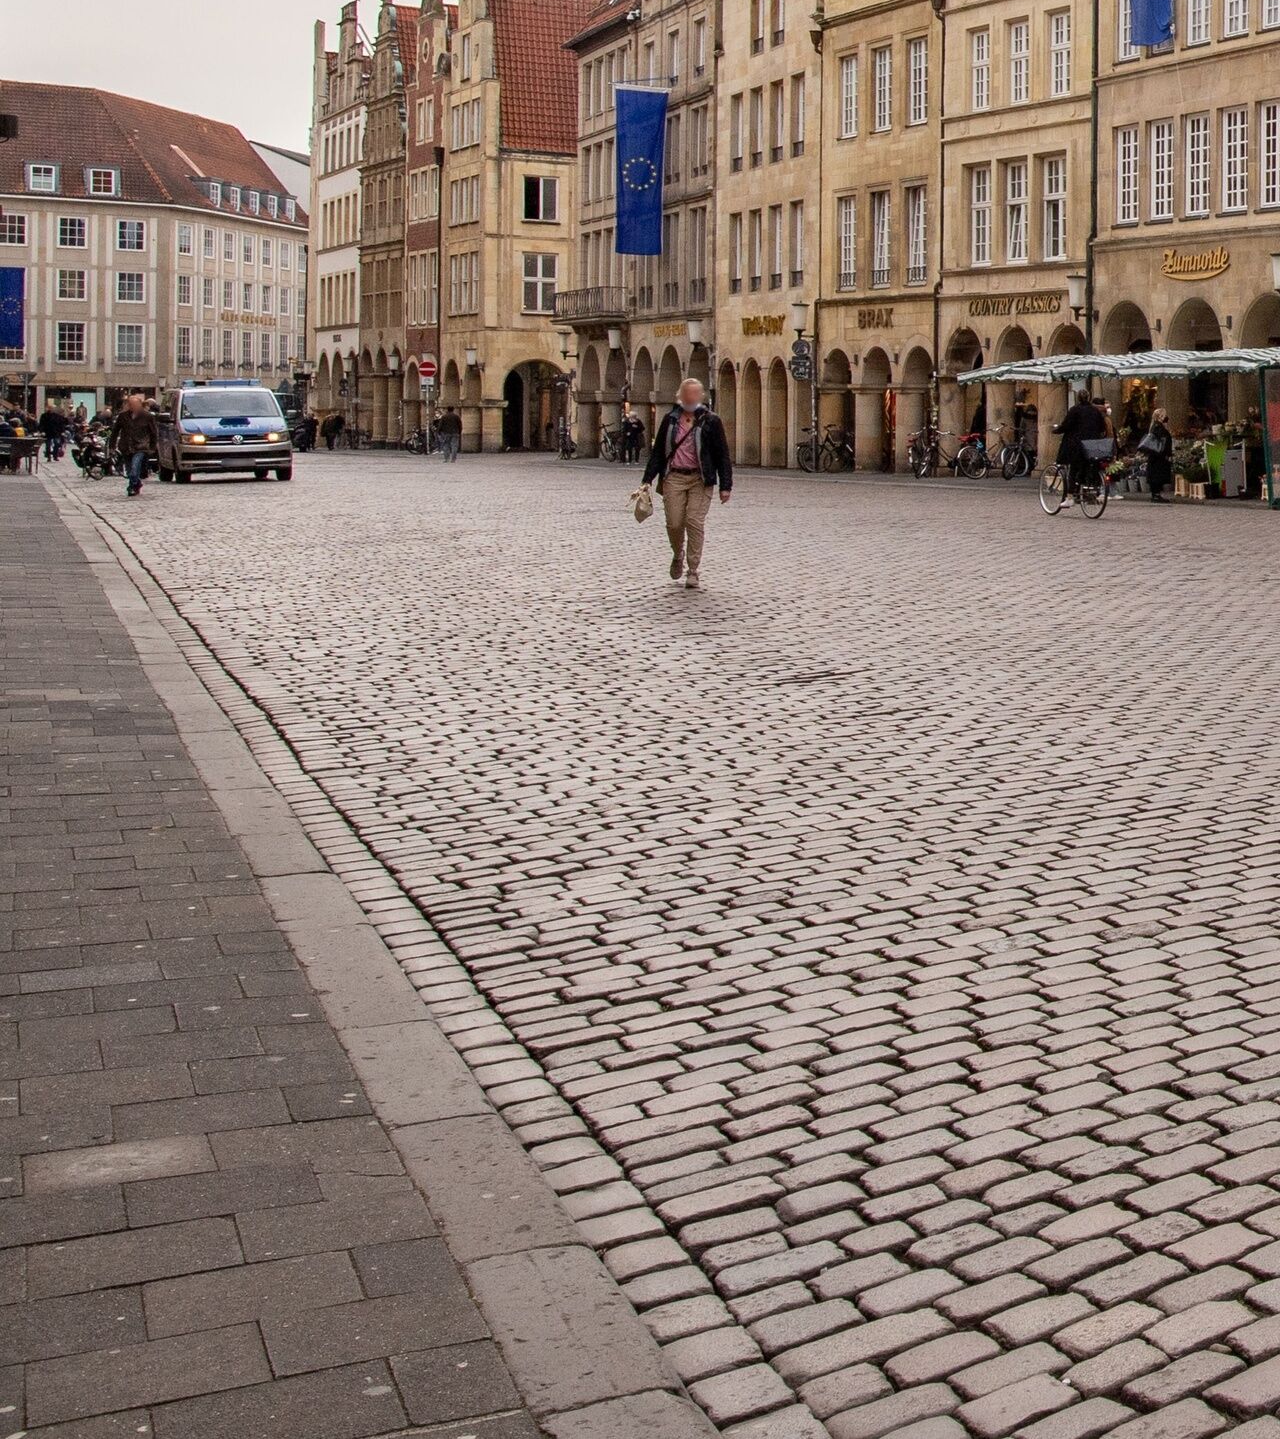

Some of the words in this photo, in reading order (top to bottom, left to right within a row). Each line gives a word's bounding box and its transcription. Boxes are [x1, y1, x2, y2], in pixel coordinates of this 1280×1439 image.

[1161, 246, 1230, 274] Zumnorde
[969, 297, 1014, 317] COUNTRY
[1016, 295, 1062, 314] CLASSICS
[857, 308, 895, 329] BRAX
